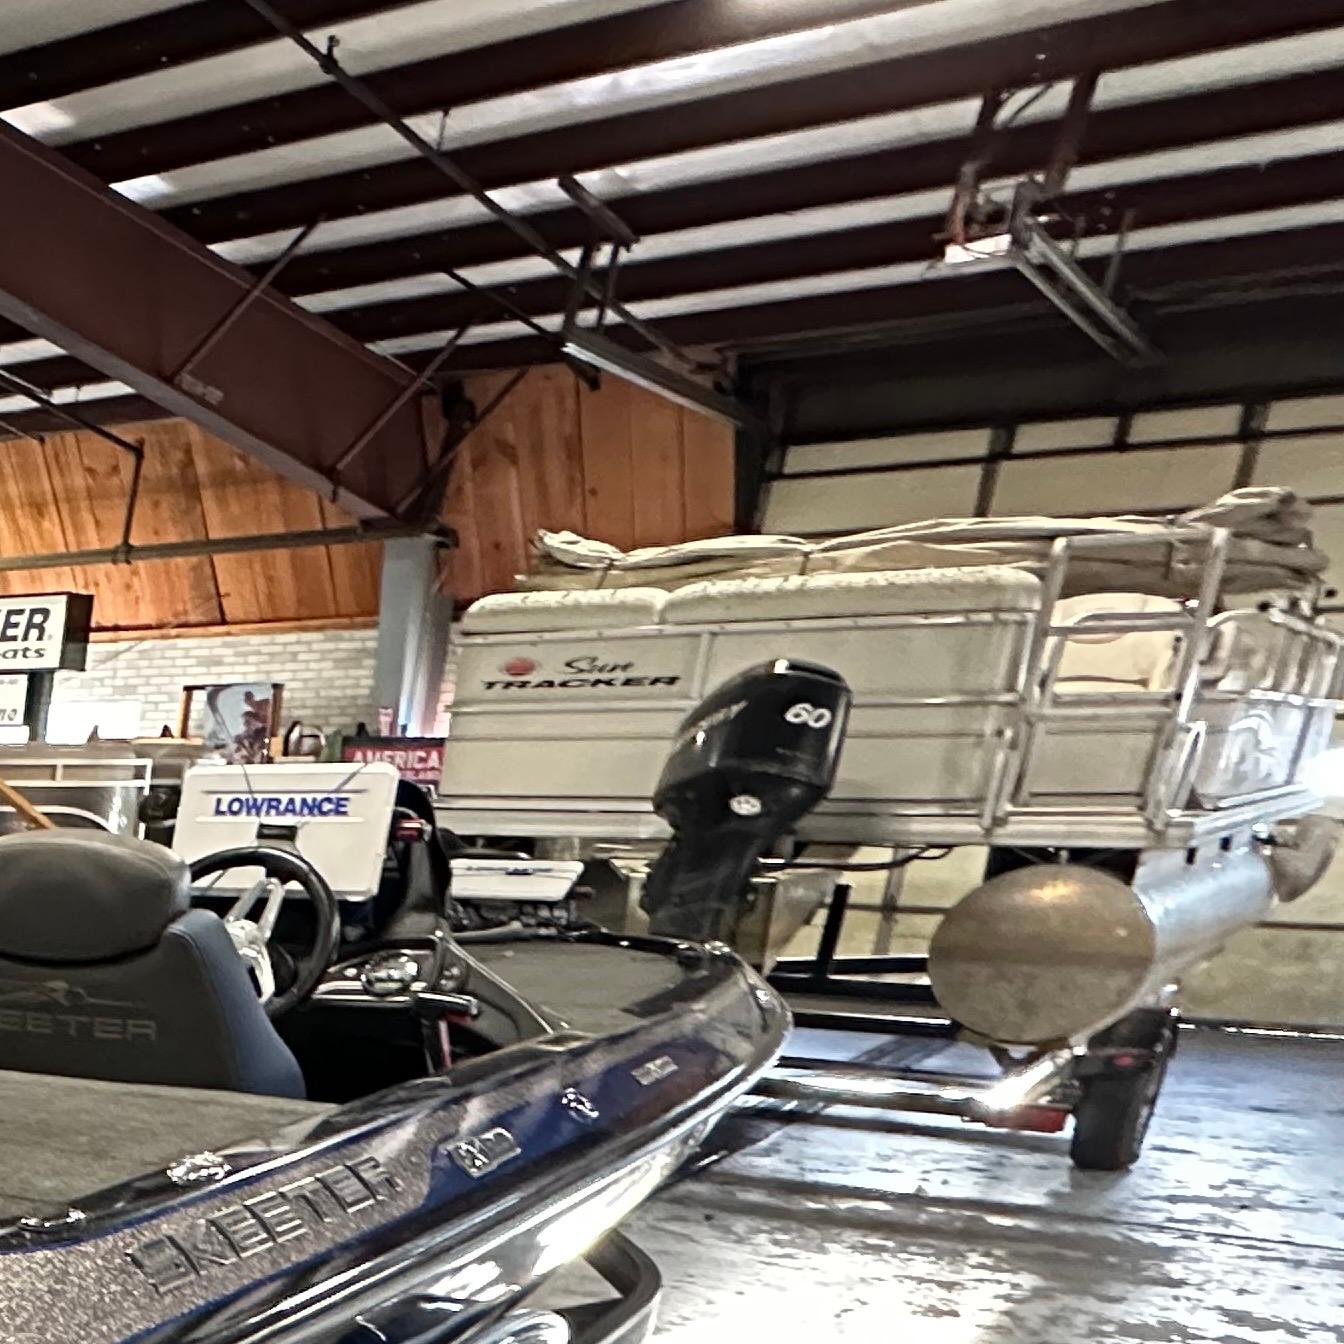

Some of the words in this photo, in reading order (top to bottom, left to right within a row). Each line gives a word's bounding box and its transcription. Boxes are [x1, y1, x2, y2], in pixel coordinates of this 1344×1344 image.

[563, 656, 635, 675] Sun
[482, 674, 682, 690] TRACKER
[784, 703, 832, 729] 60
[215, 796, 351, 817] LOWRANCE
[125, 1155, 405, 1295] SKEETER
